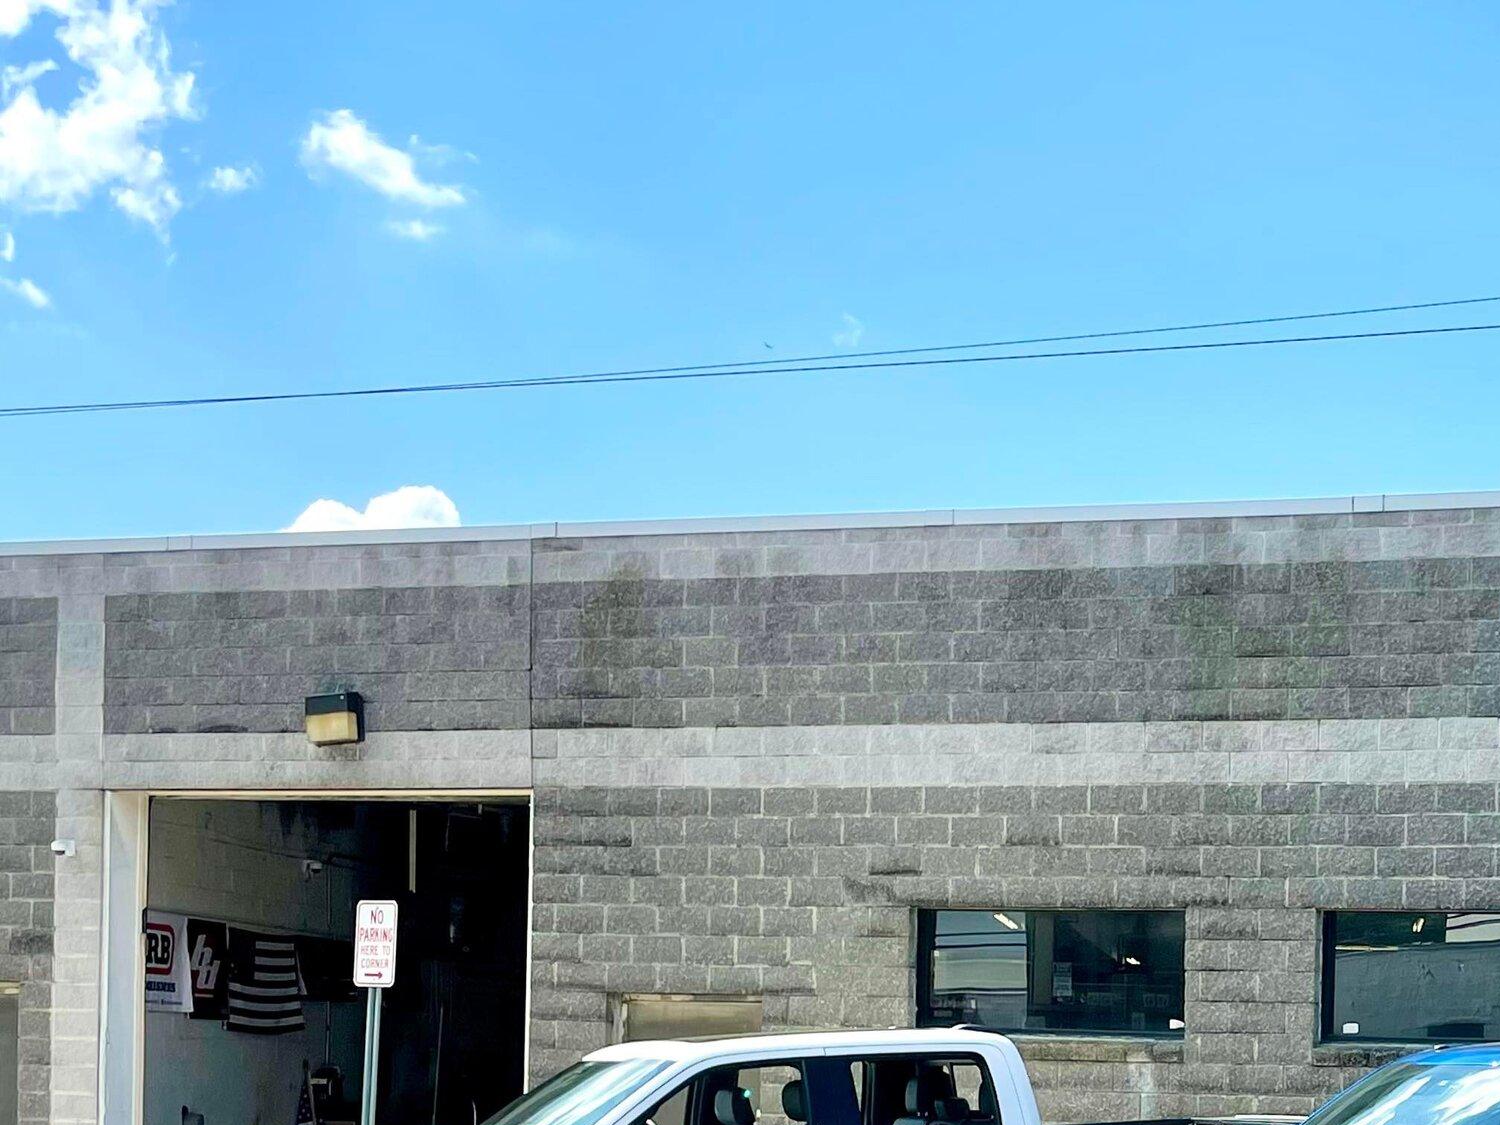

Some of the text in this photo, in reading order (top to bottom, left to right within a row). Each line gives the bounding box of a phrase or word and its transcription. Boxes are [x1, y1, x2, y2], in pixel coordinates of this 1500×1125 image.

[370, 909, 384, 925] NO
[359, 928, 394, 943] PARKING
[360, 945, 391, 956] HERE TO
[360, 958, 389, 969] CORNER
